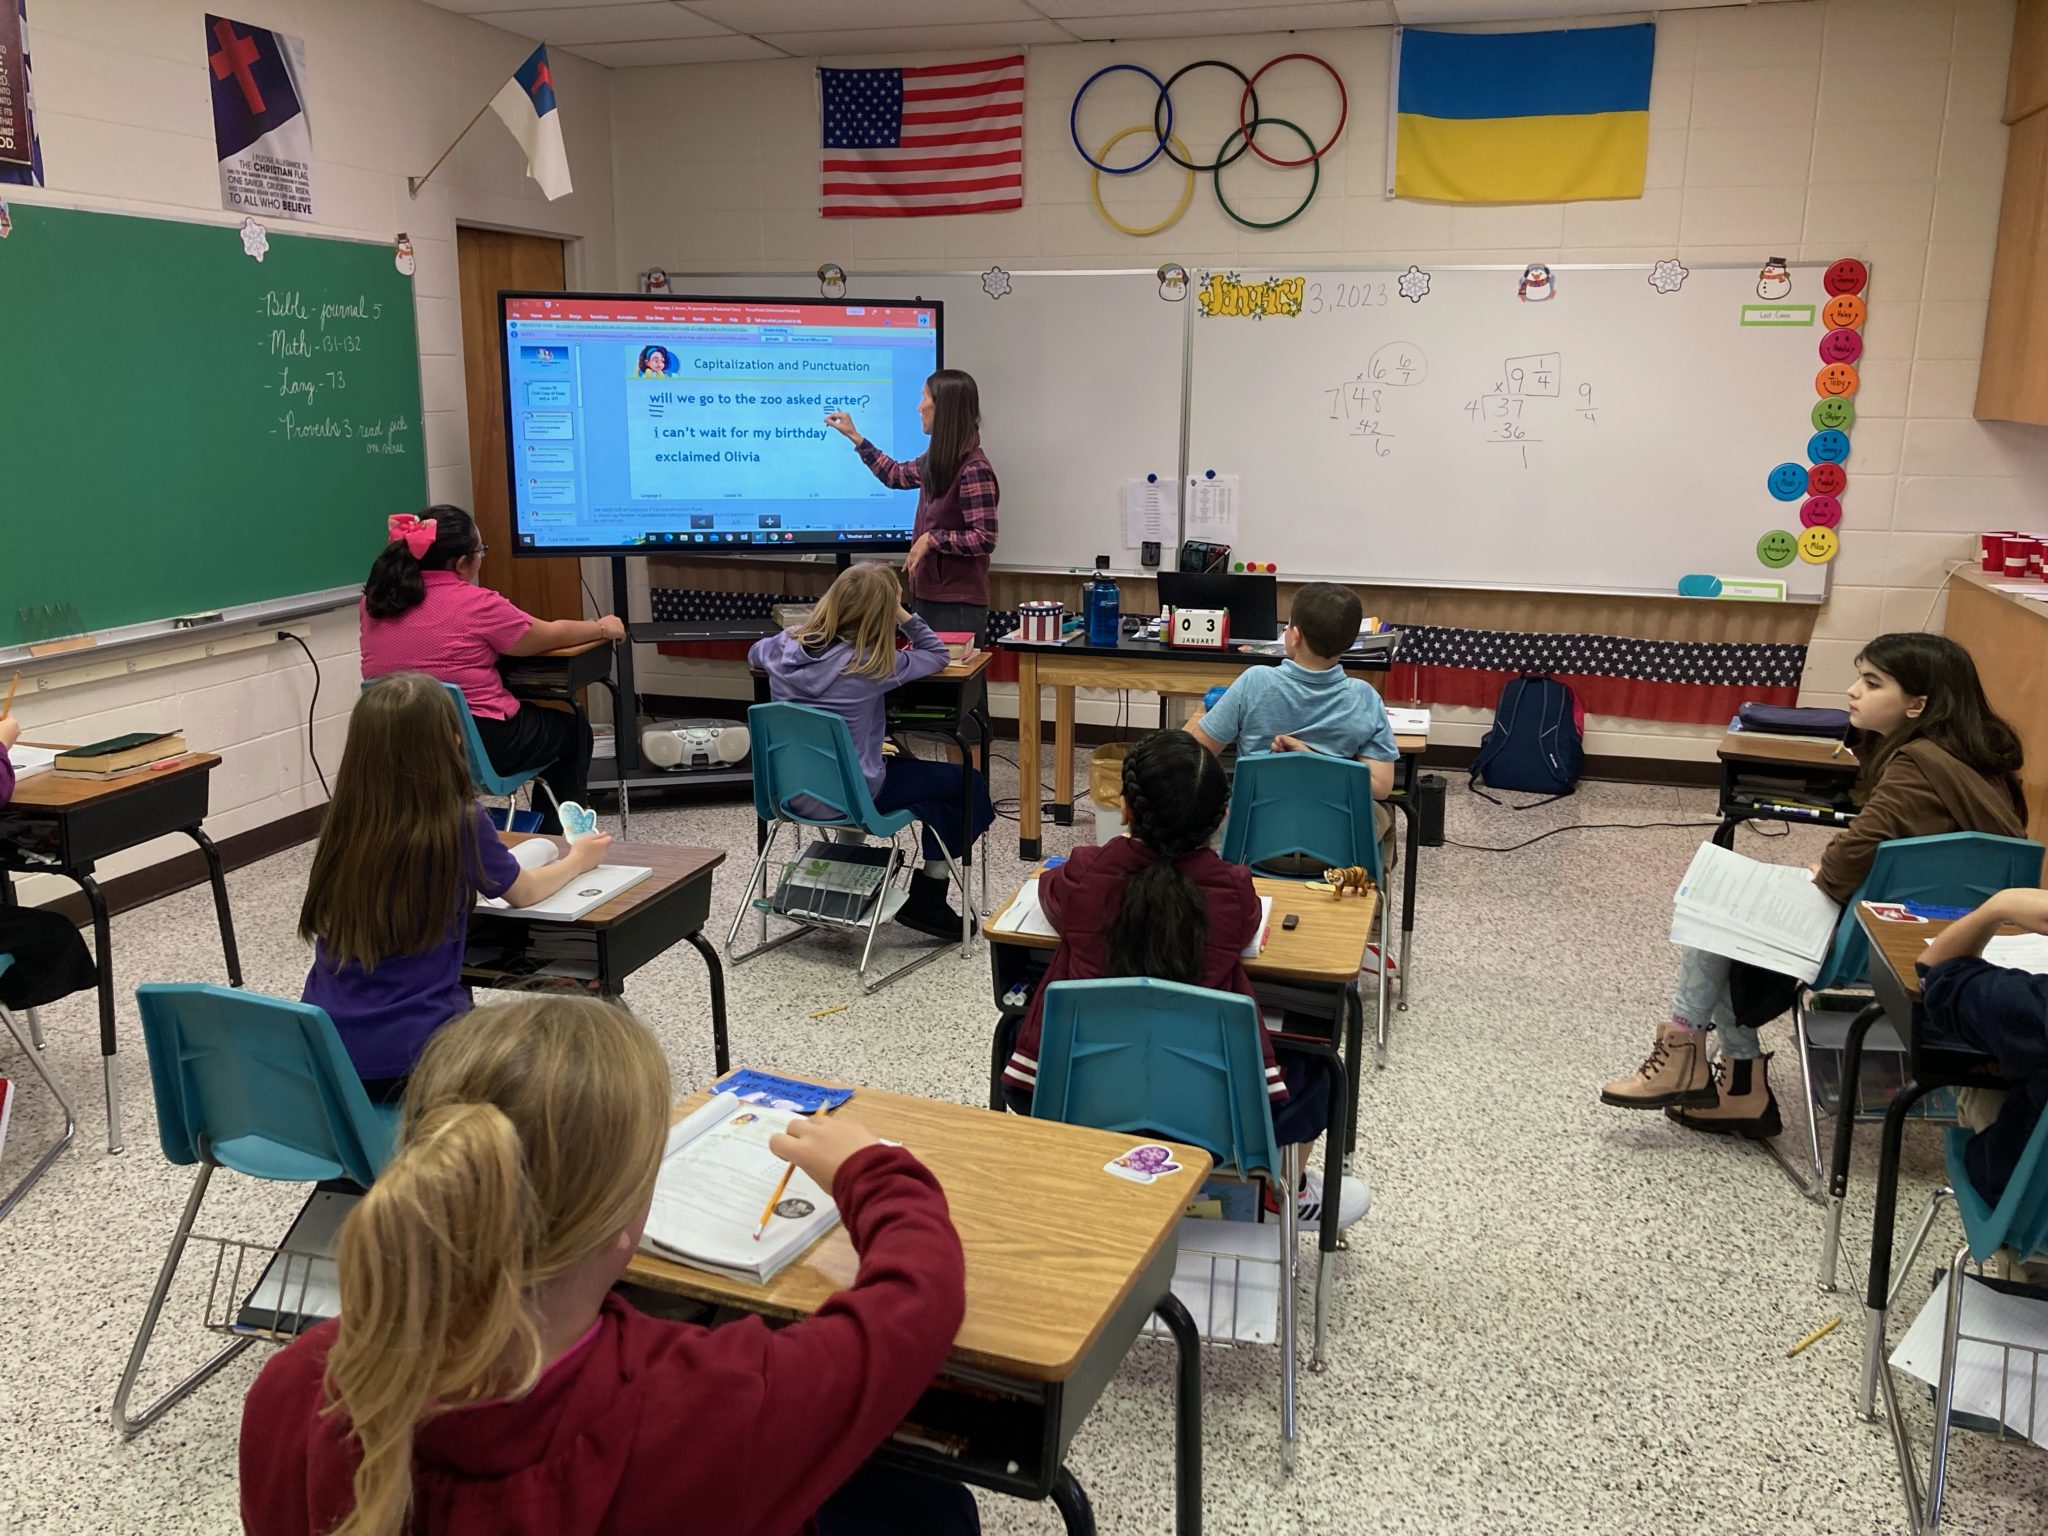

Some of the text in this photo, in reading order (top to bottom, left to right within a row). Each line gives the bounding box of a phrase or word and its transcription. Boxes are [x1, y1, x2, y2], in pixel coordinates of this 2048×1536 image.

[0, 136, 17, 150] OD.
[239, 160, 252, 171] THE
[253, 162, 293, 178] CHRISTIAN
[228, 175, 243, 185] ONE
[229, 192, 242, 205] TO
[243, 195, 259, 208] ALL
[260, 197, 281, 210] WHO
[259, 290, 383, 332] Bible journal 5
[267, 328, 312, 359] Math
[694, 358, 870, 374] Capitalization and Punctuation
[1372, 359, 1387, 379] 6
[1510, 367, 1524, 393] 9
[1828, 377, 1846, 390] Toby
[649, 392, 673, 404] will
[677, 394, 696, 404] we
[699, 394, 714, 407] go
[718, 393, 731, 405] to
[735, 392, 756, 405] the
[760, 396, 783, 405] zoo
[786, 393, 822, 406] asked
[1352, 387, 1382, 414] 48
[1578, 382, 1592, 406] 9
[1463, 398, 1524, 423] 4 37
[278, 410, 342, 440] Proverbs
[342, 418, 353, 438] 3
[699, 427, 727, 439] wait
[730, 427, 749, 439] for
[753, 429, 771, 441] my
[775, 427, 828, 441] birthday
[655, 450, 761, 463] exclaimed Olivia
[1375, 438, 1391, 457] 6
[1181, 618, 1216, 632] 0 3
[1182, 637, 1215, 645] JANUARY
